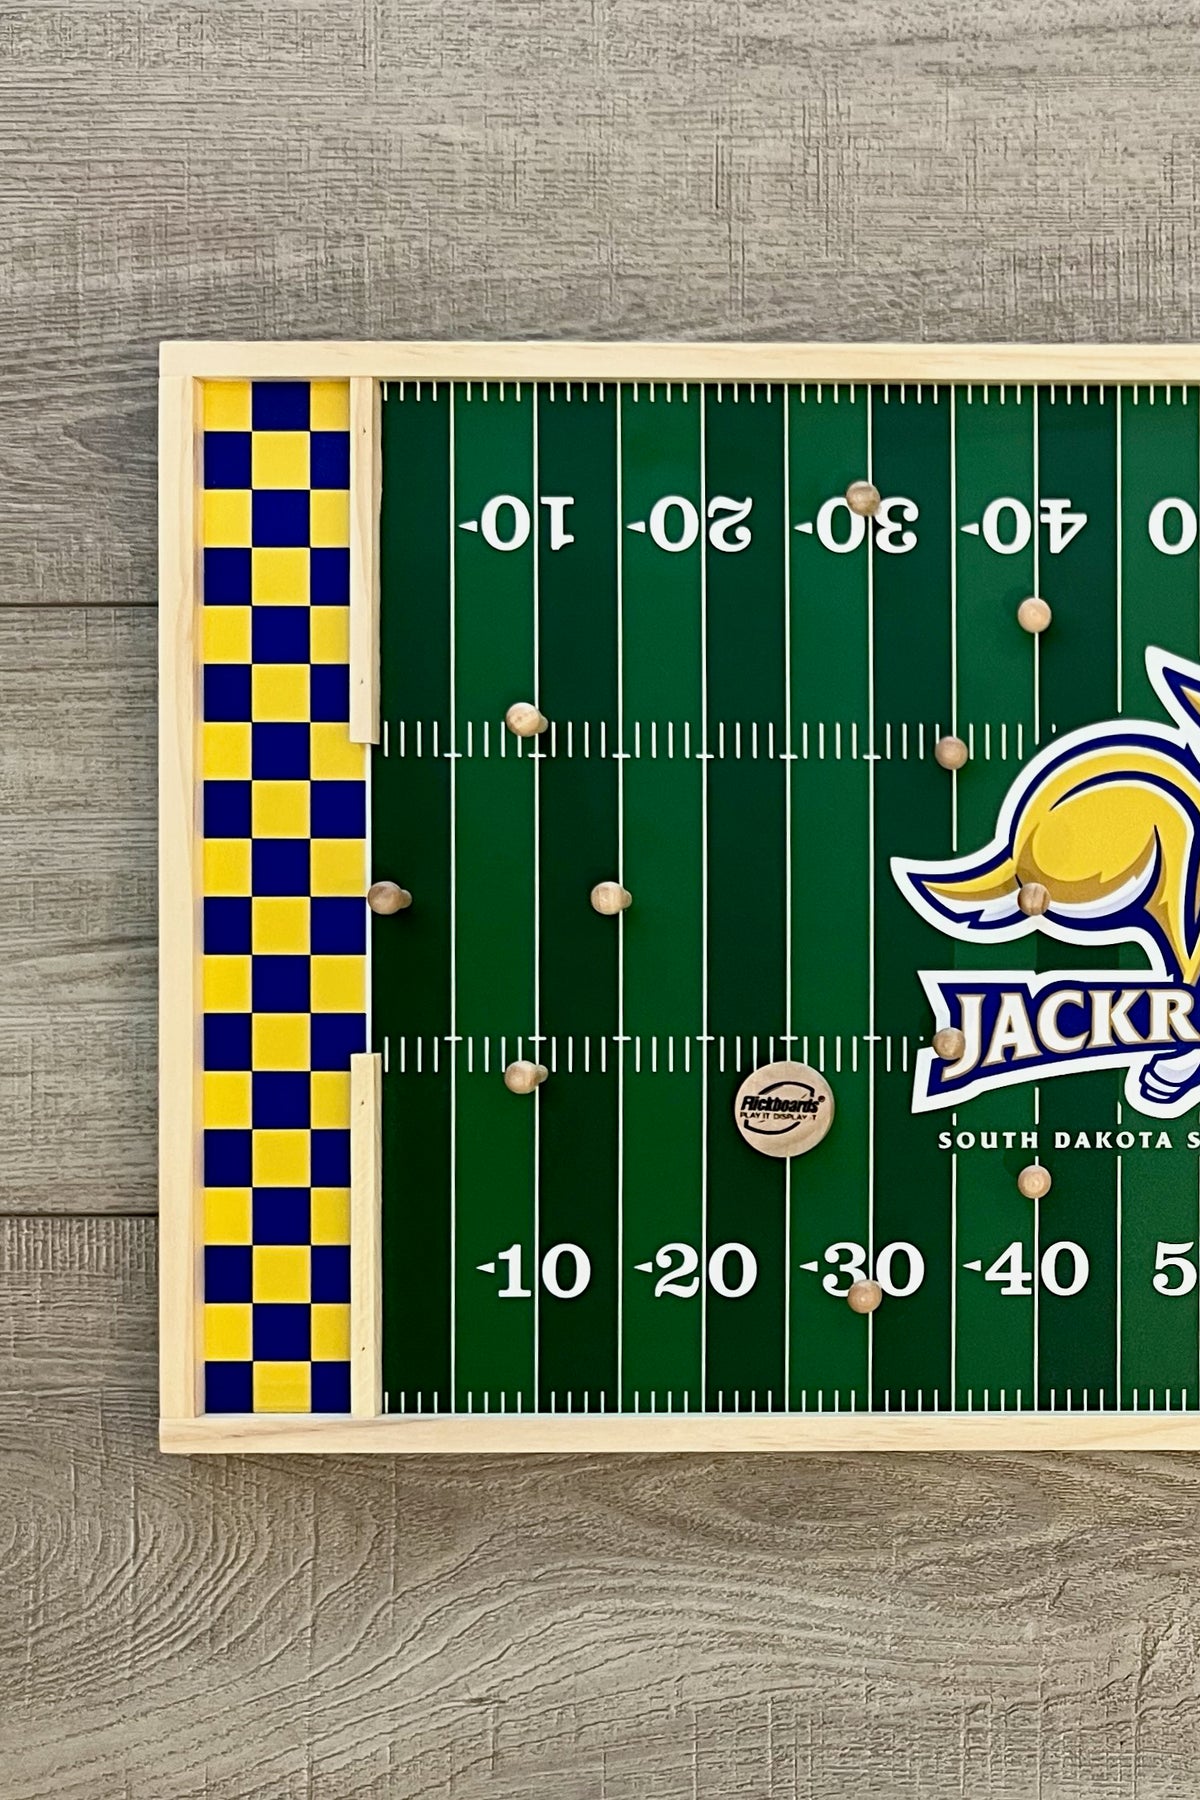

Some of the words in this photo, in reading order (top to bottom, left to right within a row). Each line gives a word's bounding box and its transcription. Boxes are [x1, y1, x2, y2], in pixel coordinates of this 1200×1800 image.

[480, 494, 574, 551] 10
[649, 495, 752, 553] 20
[816, 496, 919, 554] 30
[982, 497, 1088, 555] 40
[773, 1113, 808, 1121] DISPLAY
[938, 1131, 1038, 1149] SOUTH
[1054, 1131, 1173, 1149] DAKOTA
[497, 1243, 591, 1298] 10
[654, 1242, 758, 1298] 20
[822, 1241, 925, 1297] 30
[984, 1241, 1090, 1296] 40
